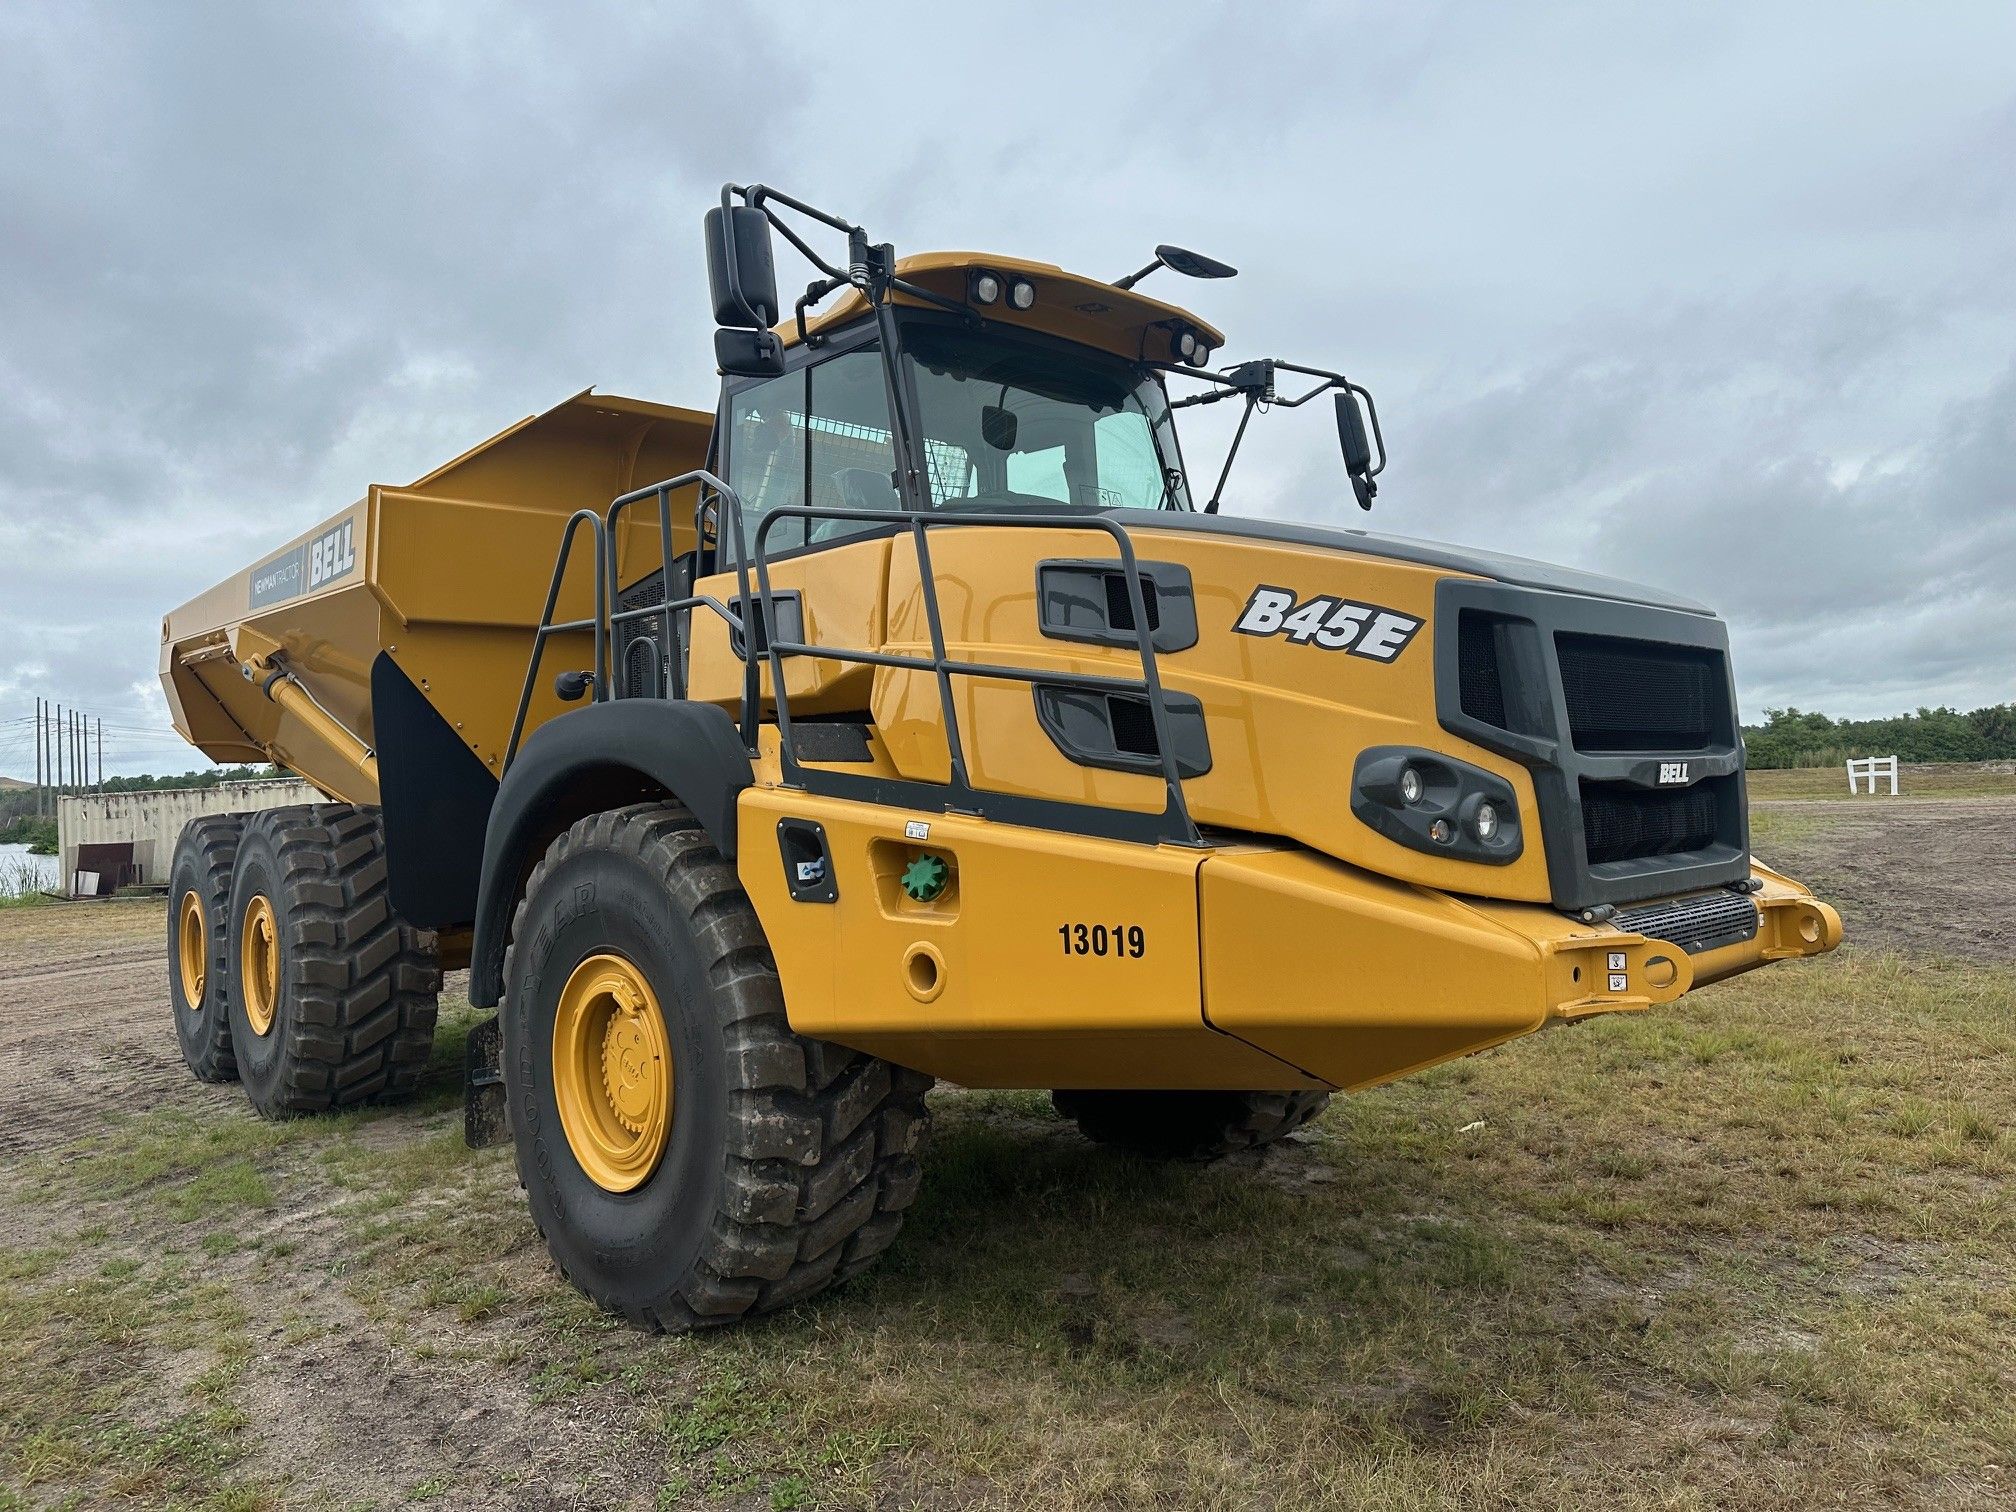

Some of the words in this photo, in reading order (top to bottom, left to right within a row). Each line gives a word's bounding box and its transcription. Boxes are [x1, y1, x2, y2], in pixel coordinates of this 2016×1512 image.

[310, 521, 354, 588] BELL
[1234, 587, 1421, 661] B45E
[1659, 762, 1689, 784] BELL
[1058, 923, 1145, 959] 13019
